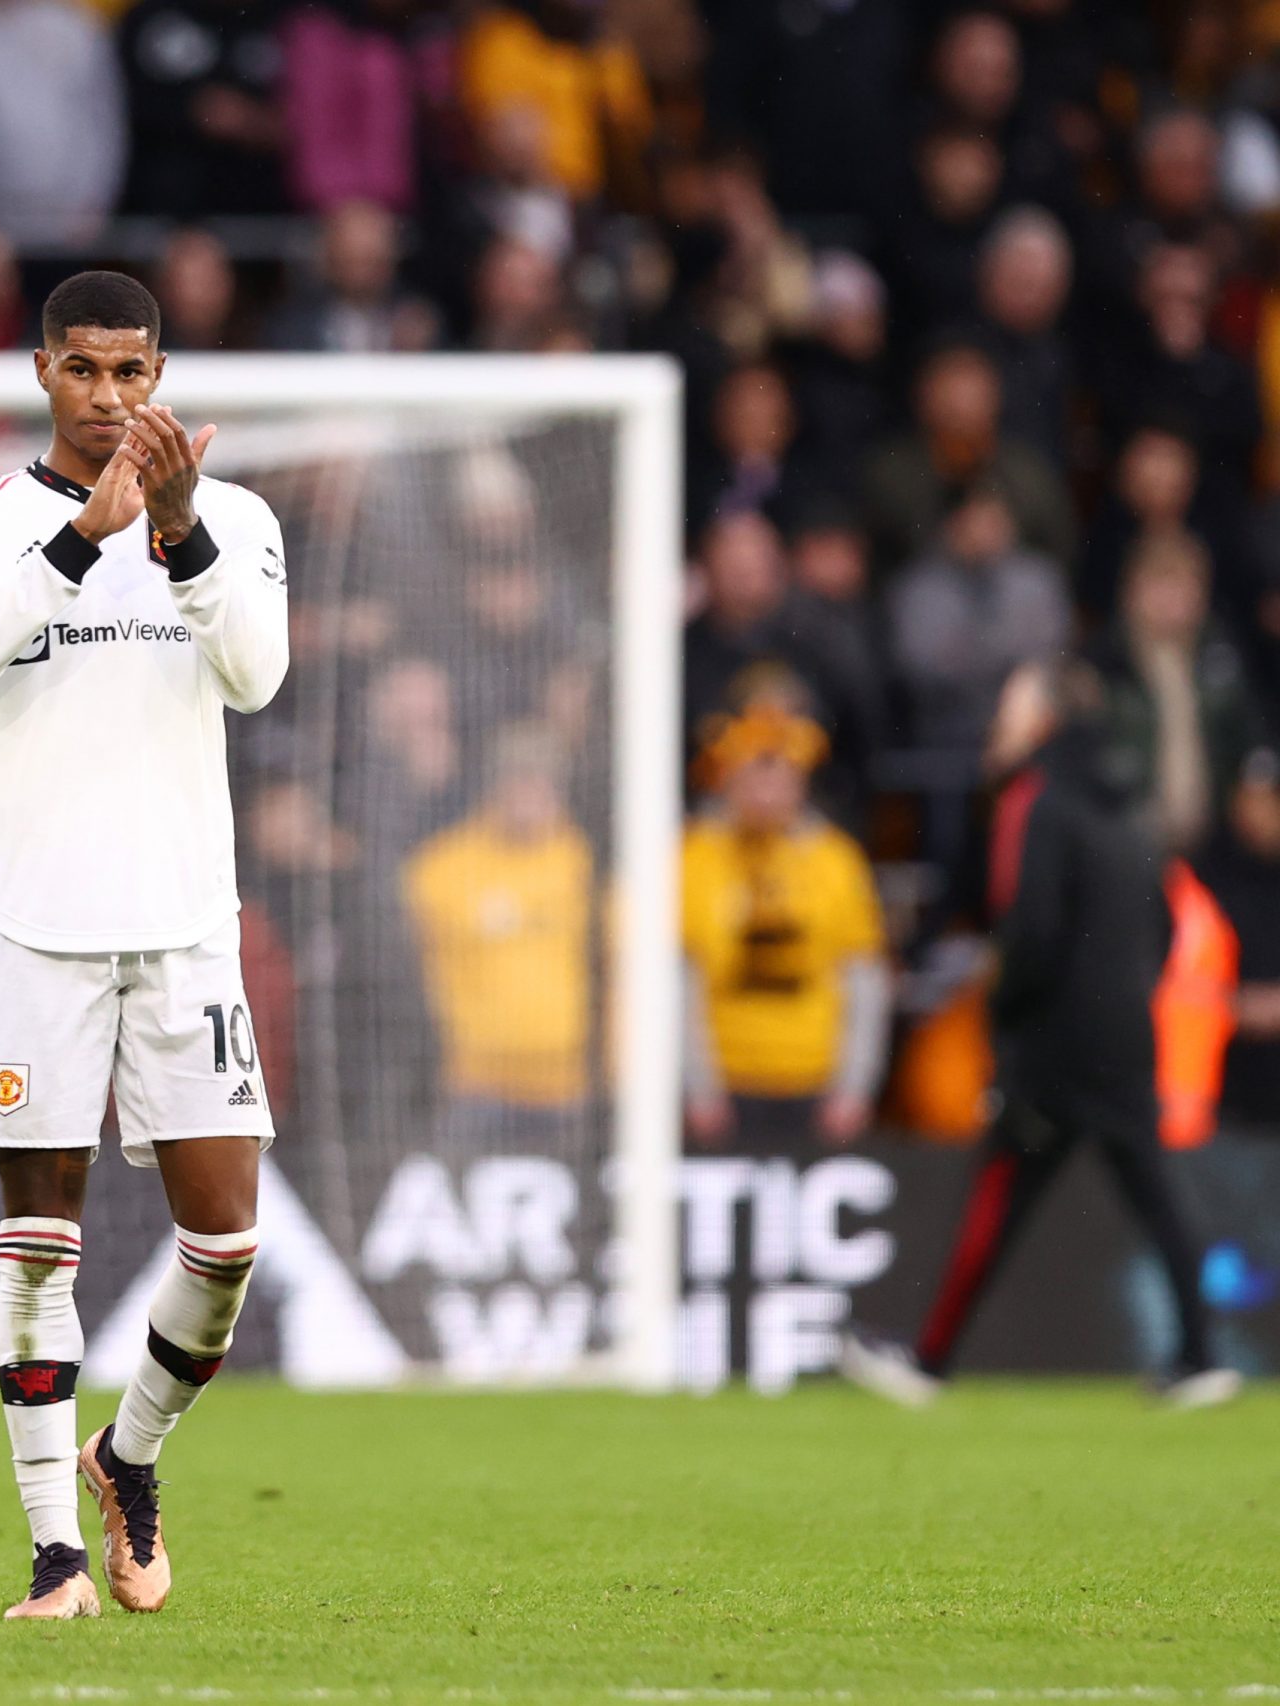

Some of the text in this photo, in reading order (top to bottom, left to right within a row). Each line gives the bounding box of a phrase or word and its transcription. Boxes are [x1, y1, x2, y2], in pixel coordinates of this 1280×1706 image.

[204, 1004, 255, 1073] 10
[228, 1093, 258, 1106] adidas
[362, 1154, 897, 1284] ARTIC
